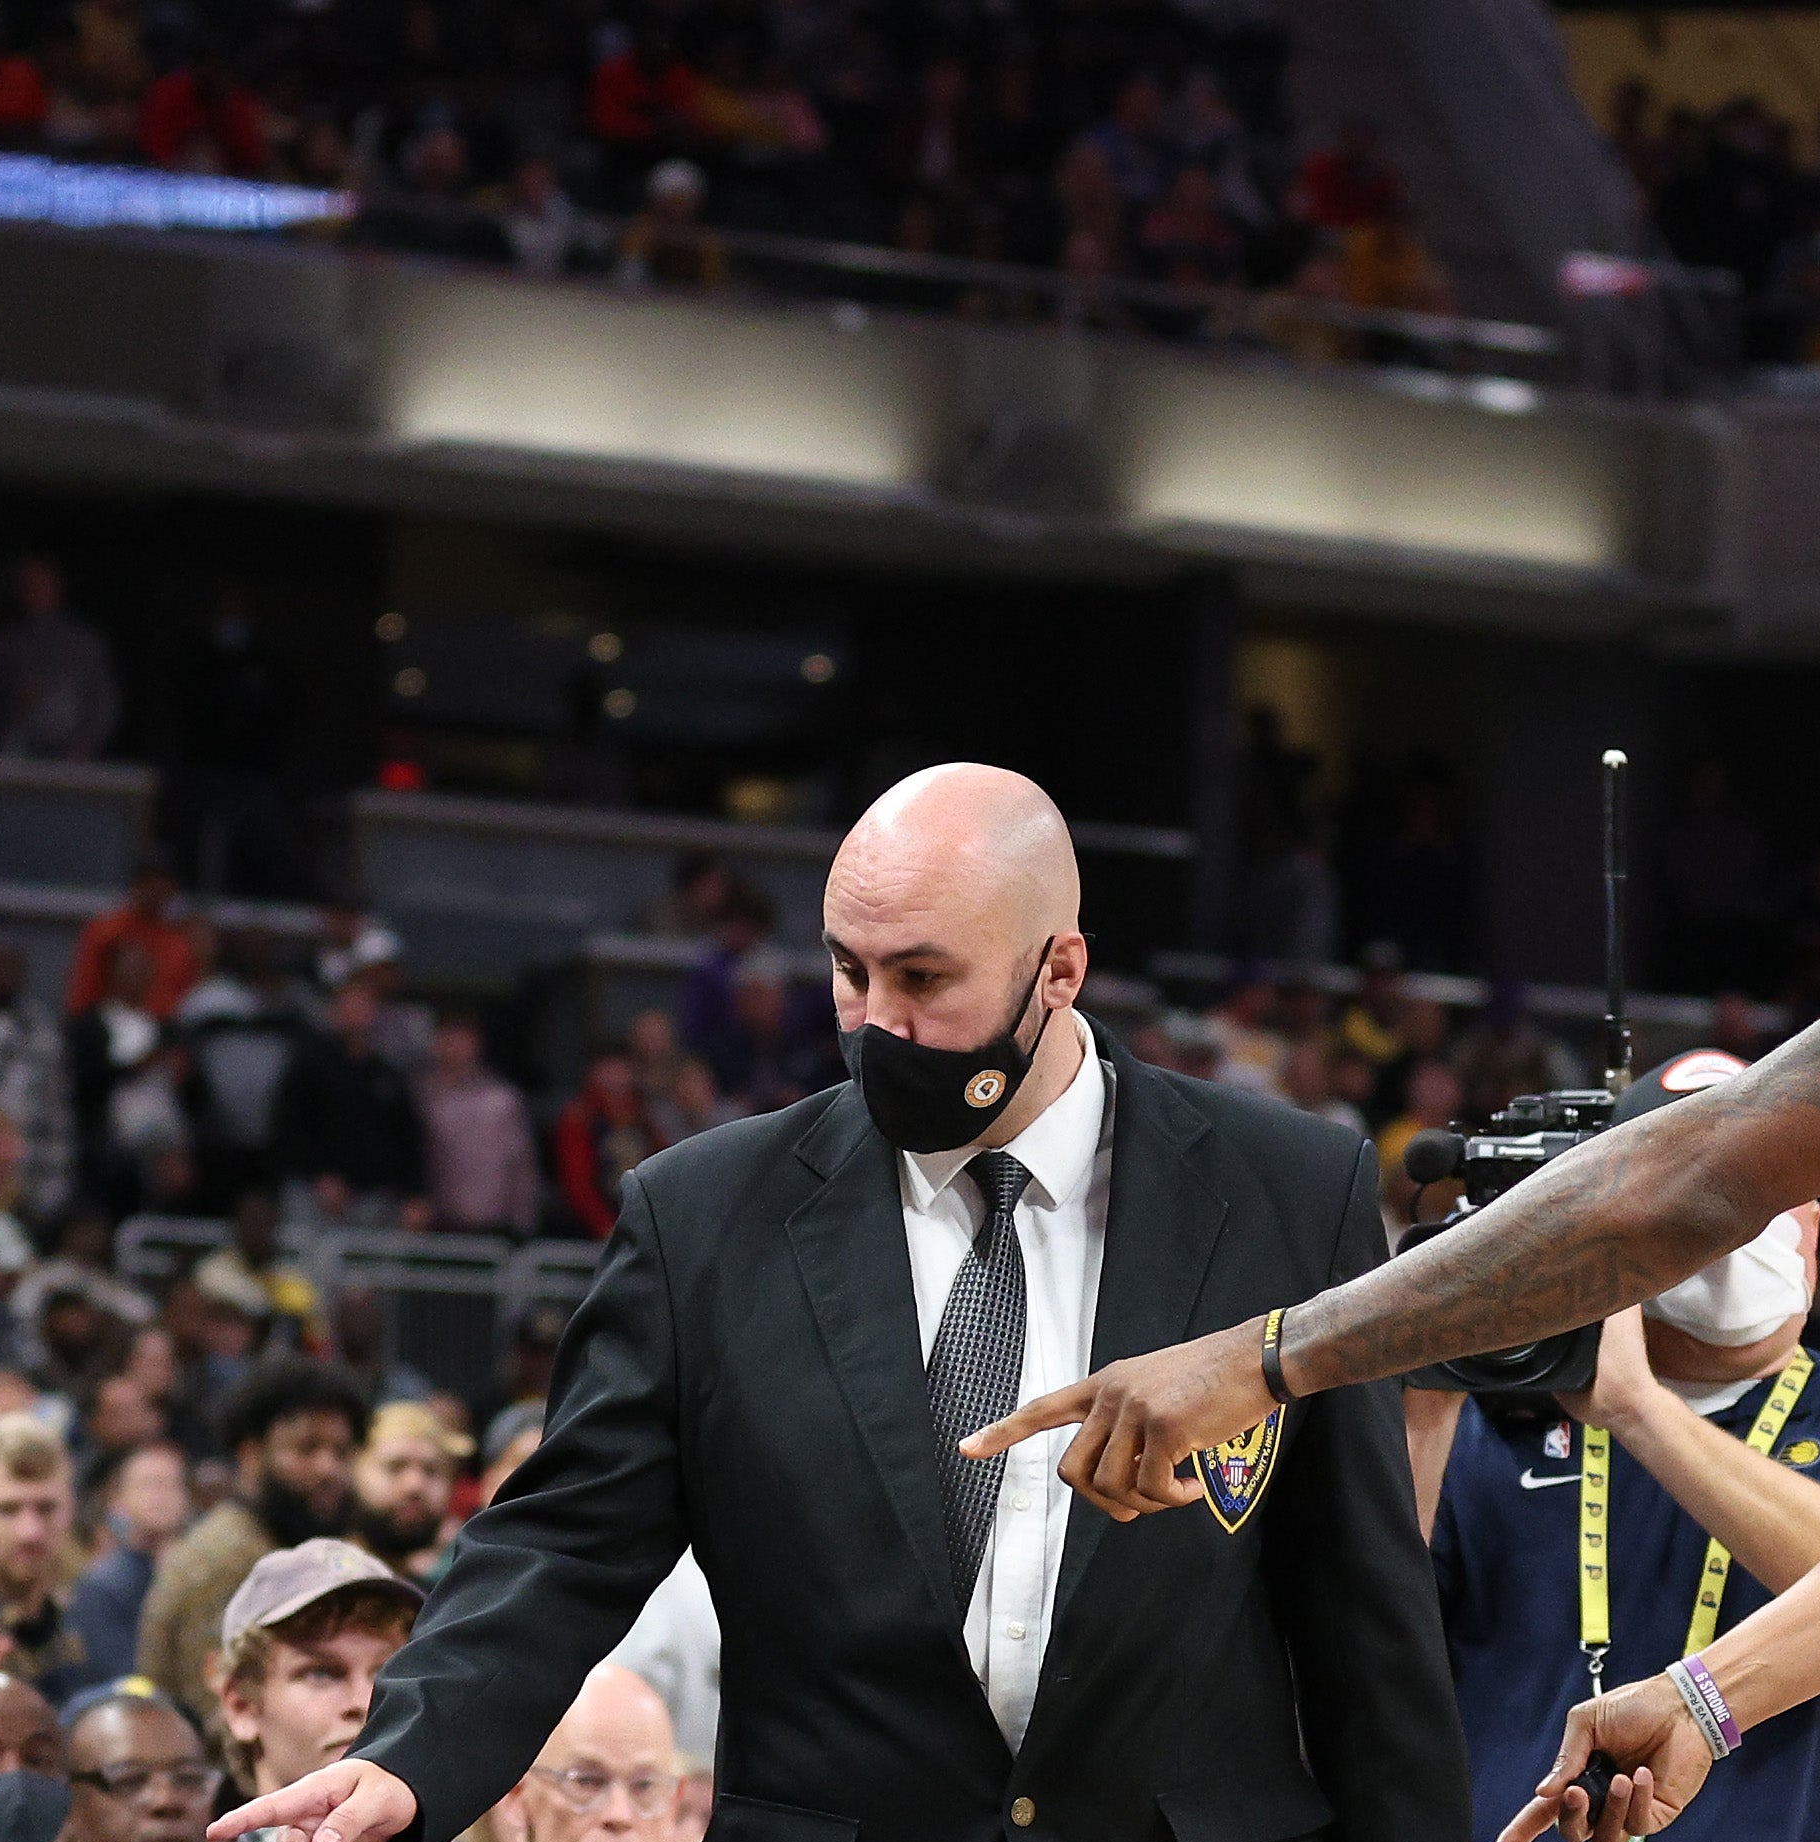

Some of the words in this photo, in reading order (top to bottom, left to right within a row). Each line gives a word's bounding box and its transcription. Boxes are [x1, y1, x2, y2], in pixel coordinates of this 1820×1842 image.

[1694, 1672, 1709, 1683] 6
[1679, 1675, 1700, 1706] Racism
[1695, 1706, 1707, 1720] VS
[1699, 1680, 1732, 1724] STRONG
